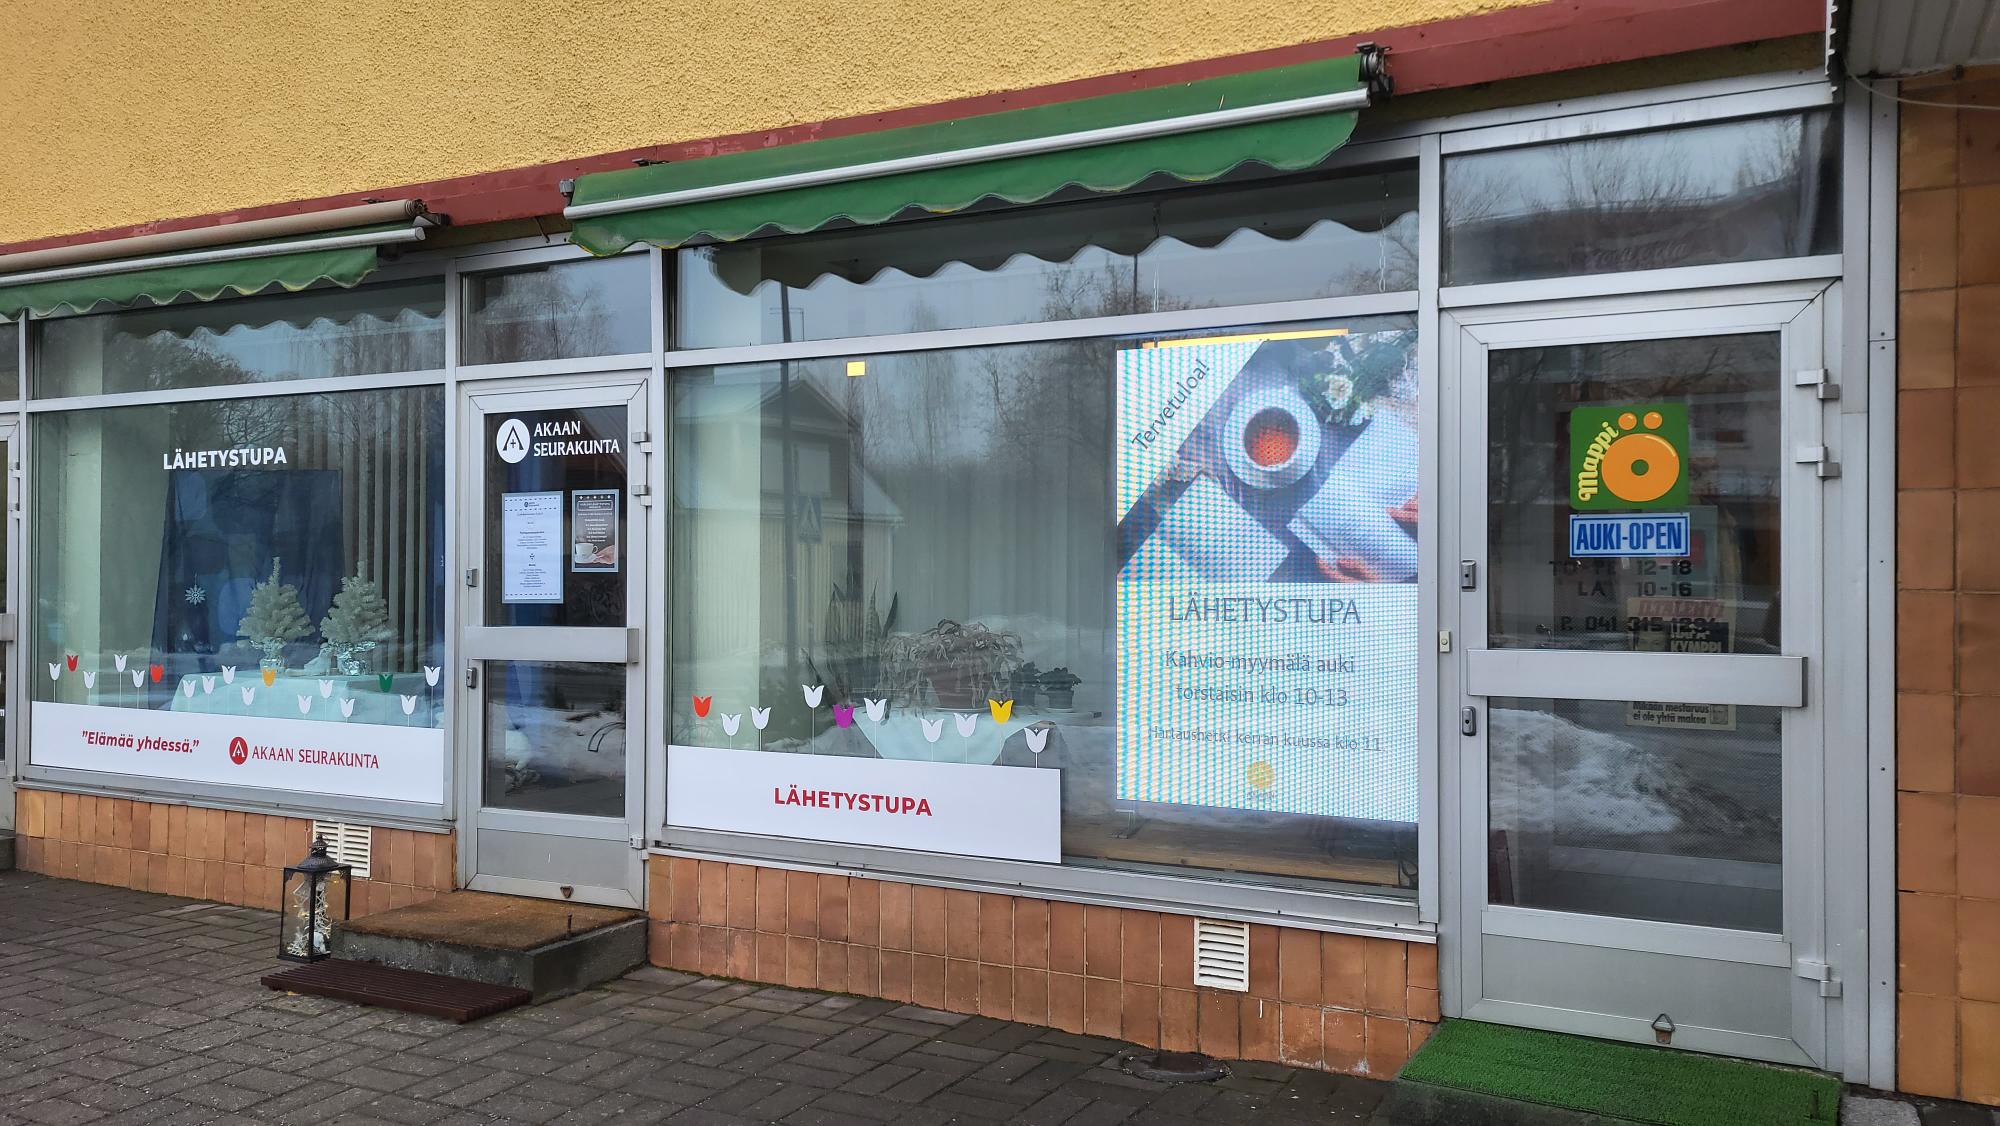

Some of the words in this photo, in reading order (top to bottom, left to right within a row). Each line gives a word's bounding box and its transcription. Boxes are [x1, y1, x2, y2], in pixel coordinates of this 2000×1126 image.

[1131, 358, 1211, 450] Tervetuloa!
[533, 421, 581, 437] AKAAN
[163, 446, 287, 470] LÄHETYSTUPA
[533, 439, 620, 457] SEURAKUNTA
[1578, 421, 1620, 502] Mappi
[1576, 522, 1682, 551] AUKI-OPEN
[1169, 592, 1362, 624] LÄHETYSTUPA
[1165, 650, 1310, 675] Kahvio-myymälä
[1317, 654, 1355, 674] auki
[1177, 686, 1254, 704] torstaisin
[1261, 685, 1287, 704] klo
[1294, 687, 1348, 706] 10-13
[1235, 729, 1278, 745] kerran
[1284, 732, 1330, 748] kuussa
[1335, 735, 1358, 750] klo
[251, 746, 294, 763] AKAAN
[299, 749, 379, 769] SEURAKUNTA
[774, 784, 933, 817] LÄHETYSTUPA
